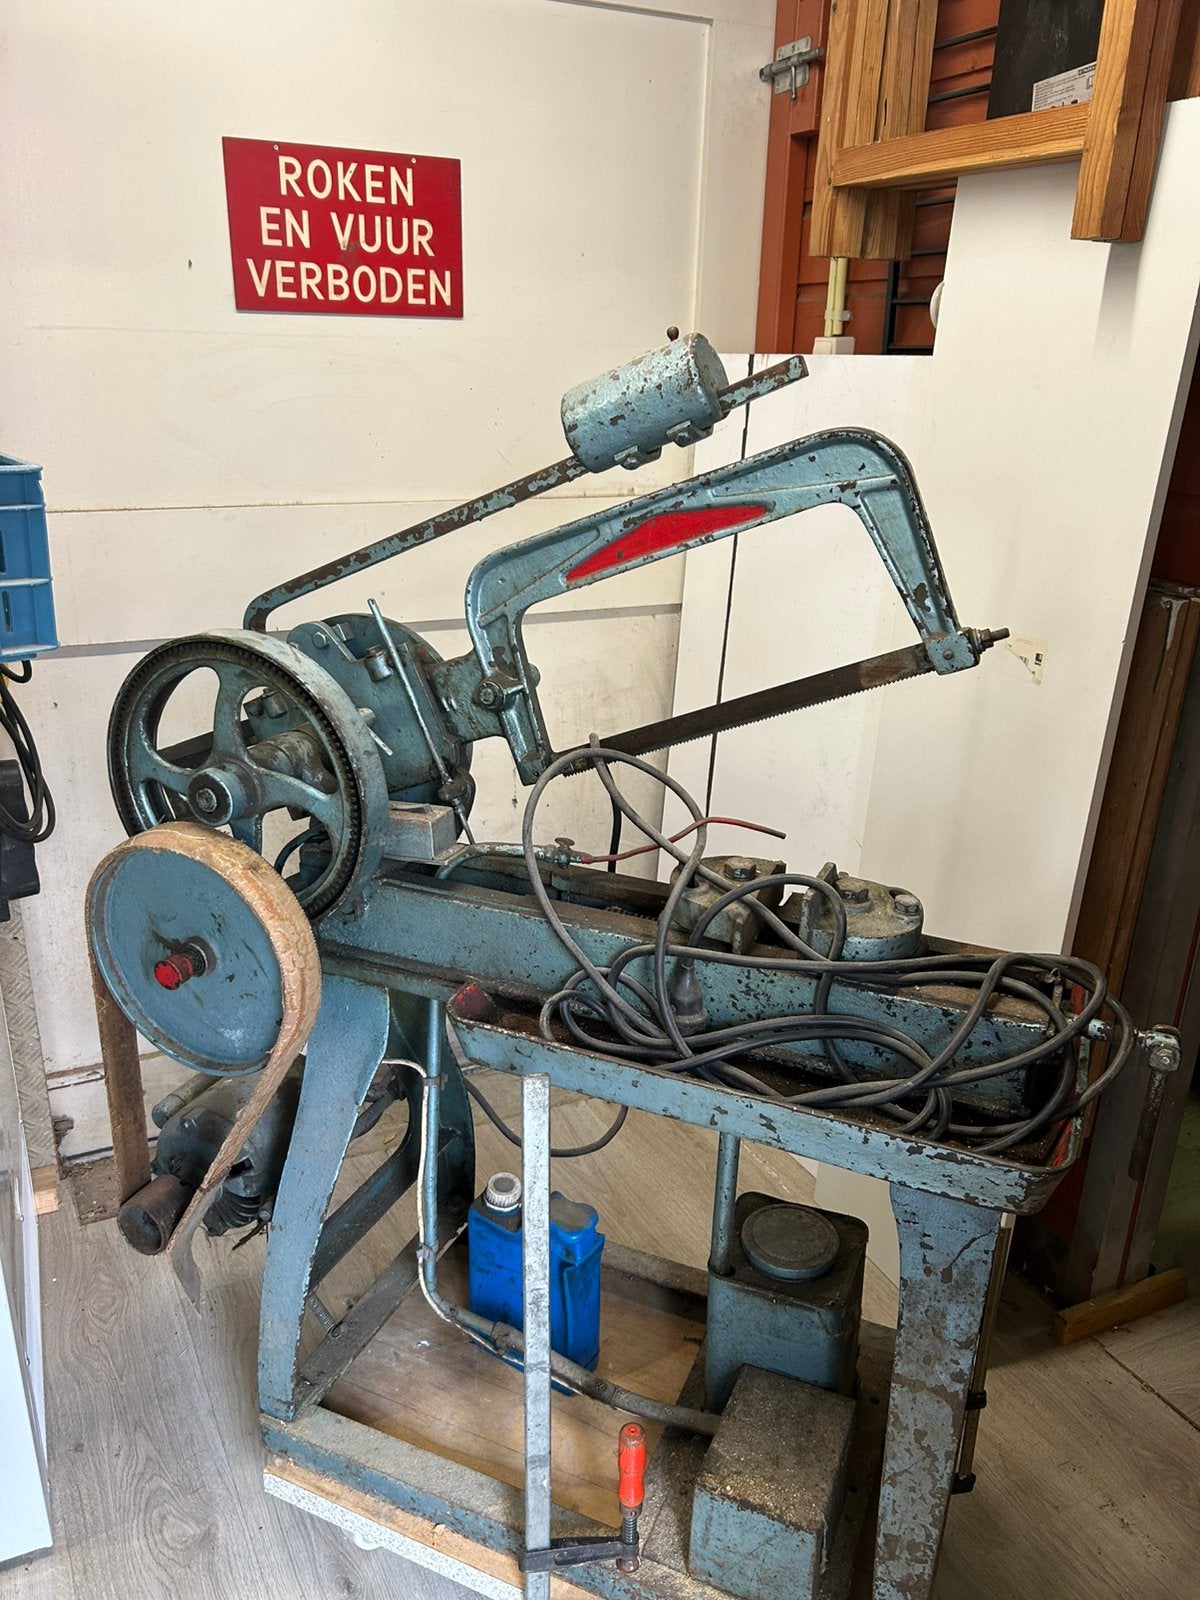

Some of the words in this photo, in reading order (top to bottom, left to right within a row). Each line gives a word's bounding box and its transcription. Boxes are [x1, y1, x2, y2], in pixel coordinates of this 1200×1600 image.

[278, 155, 414, 207] ROKEN
[259, 206, 311, 249] EN
[330, 212, 435, 257] VUUR
[246, 258, 451, 306] VERBODEN
